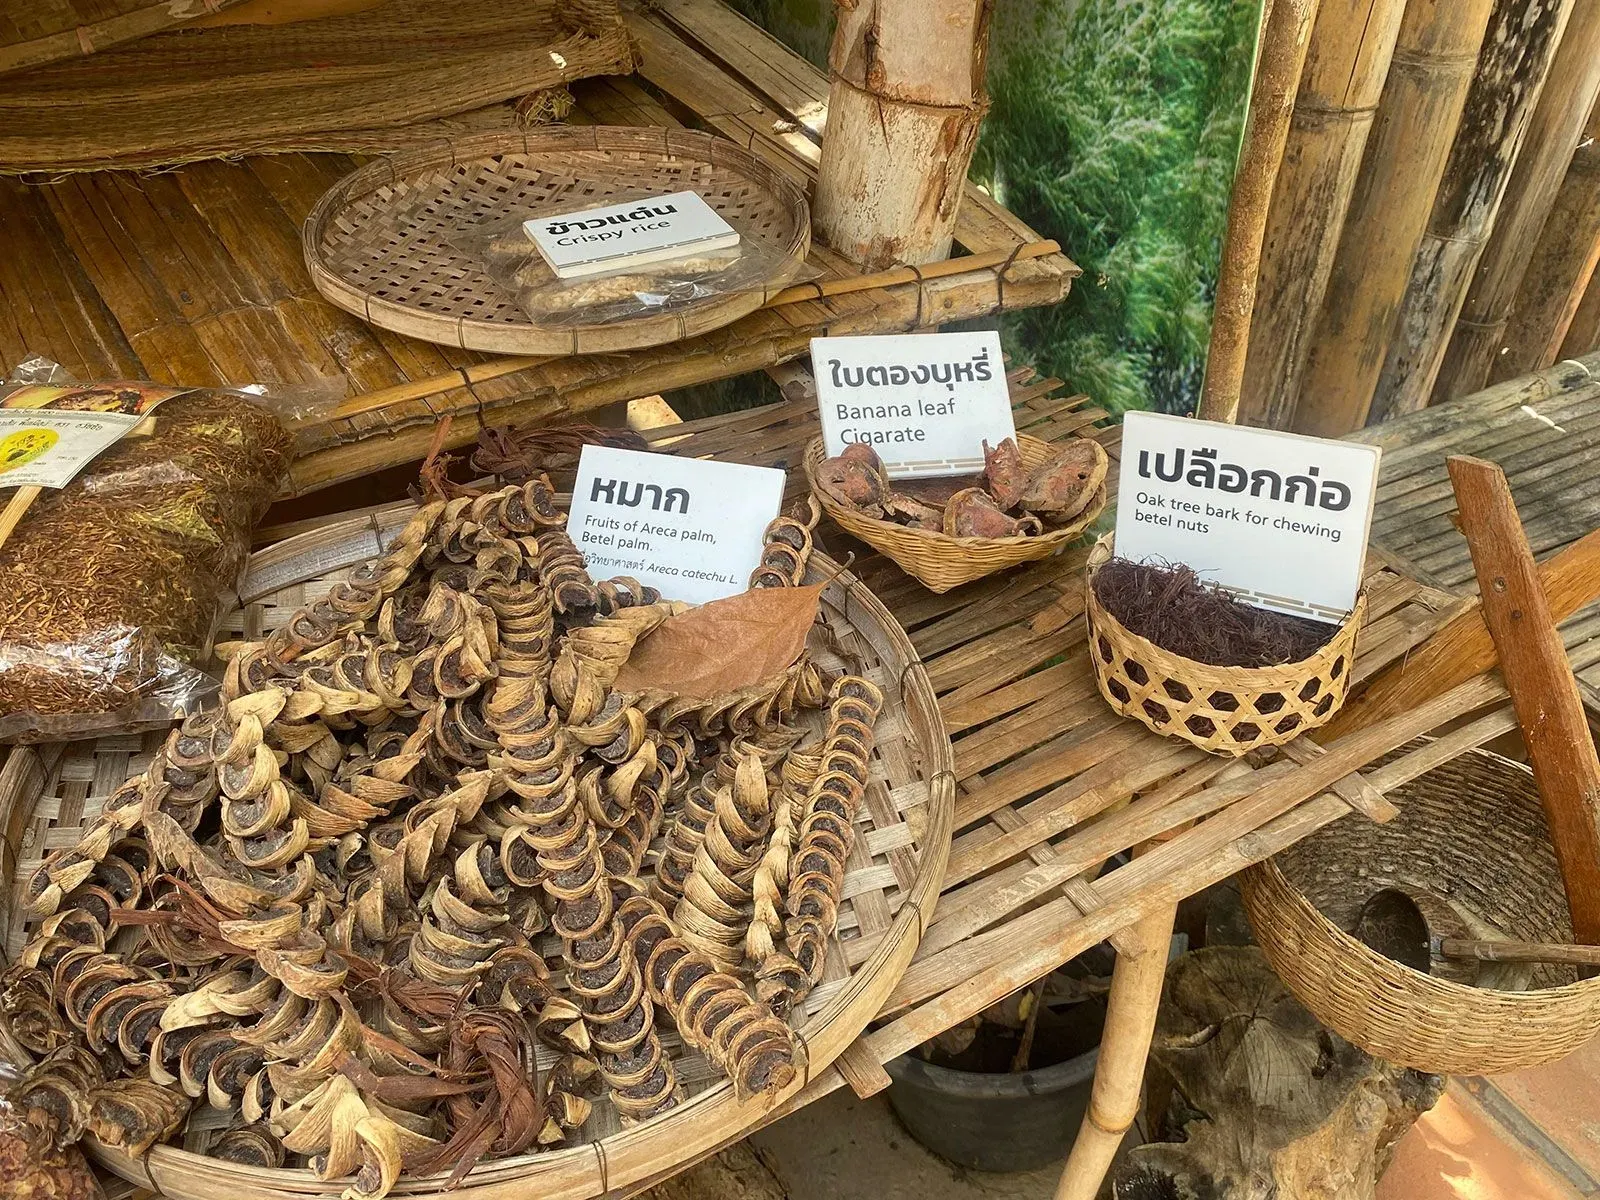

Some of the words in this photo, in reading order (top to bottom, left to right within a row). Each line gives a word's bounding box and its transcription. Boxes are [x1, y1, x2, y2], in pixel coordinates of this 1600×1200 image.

[556, 228, 624, 247] Crispy
[631, 220, 672, 234] rice
[828, 347, 992, 392] ใบตองบุหรี่
[836, 404, 912, 420] Banana
[918, 398, 956, 416] leaf
[840, 427, 926, 446] Cigarate
[1138, 447, 1351, 512] เปลือกก่อ
[590, 477, 690, 514] หมาก
[585, 515, 620, 531] Fruits
[623, 522, 639, 533] of
[640, 523, 678, 538] Areca
[681, 529, 717, 545] palm,
[1135, 508, 1172, 527] betel
[1177, 519, 1209, 534] nuts
[1136, 492, 1165, 508] Oak
[1170, 498, 1201, 514] tree
[1206, 503, 1240, 521] bark
[1246, 511, 1268, 526] for
[1273, 515, 1342, 543] chewing
[582, 531, 614, 546] Betel
[617, 537, 653, 551] palm.
[646, 563, 679, 576] Areca
[682, 569, 729, 583] catechu
[729, 575, 738, 585] L.
